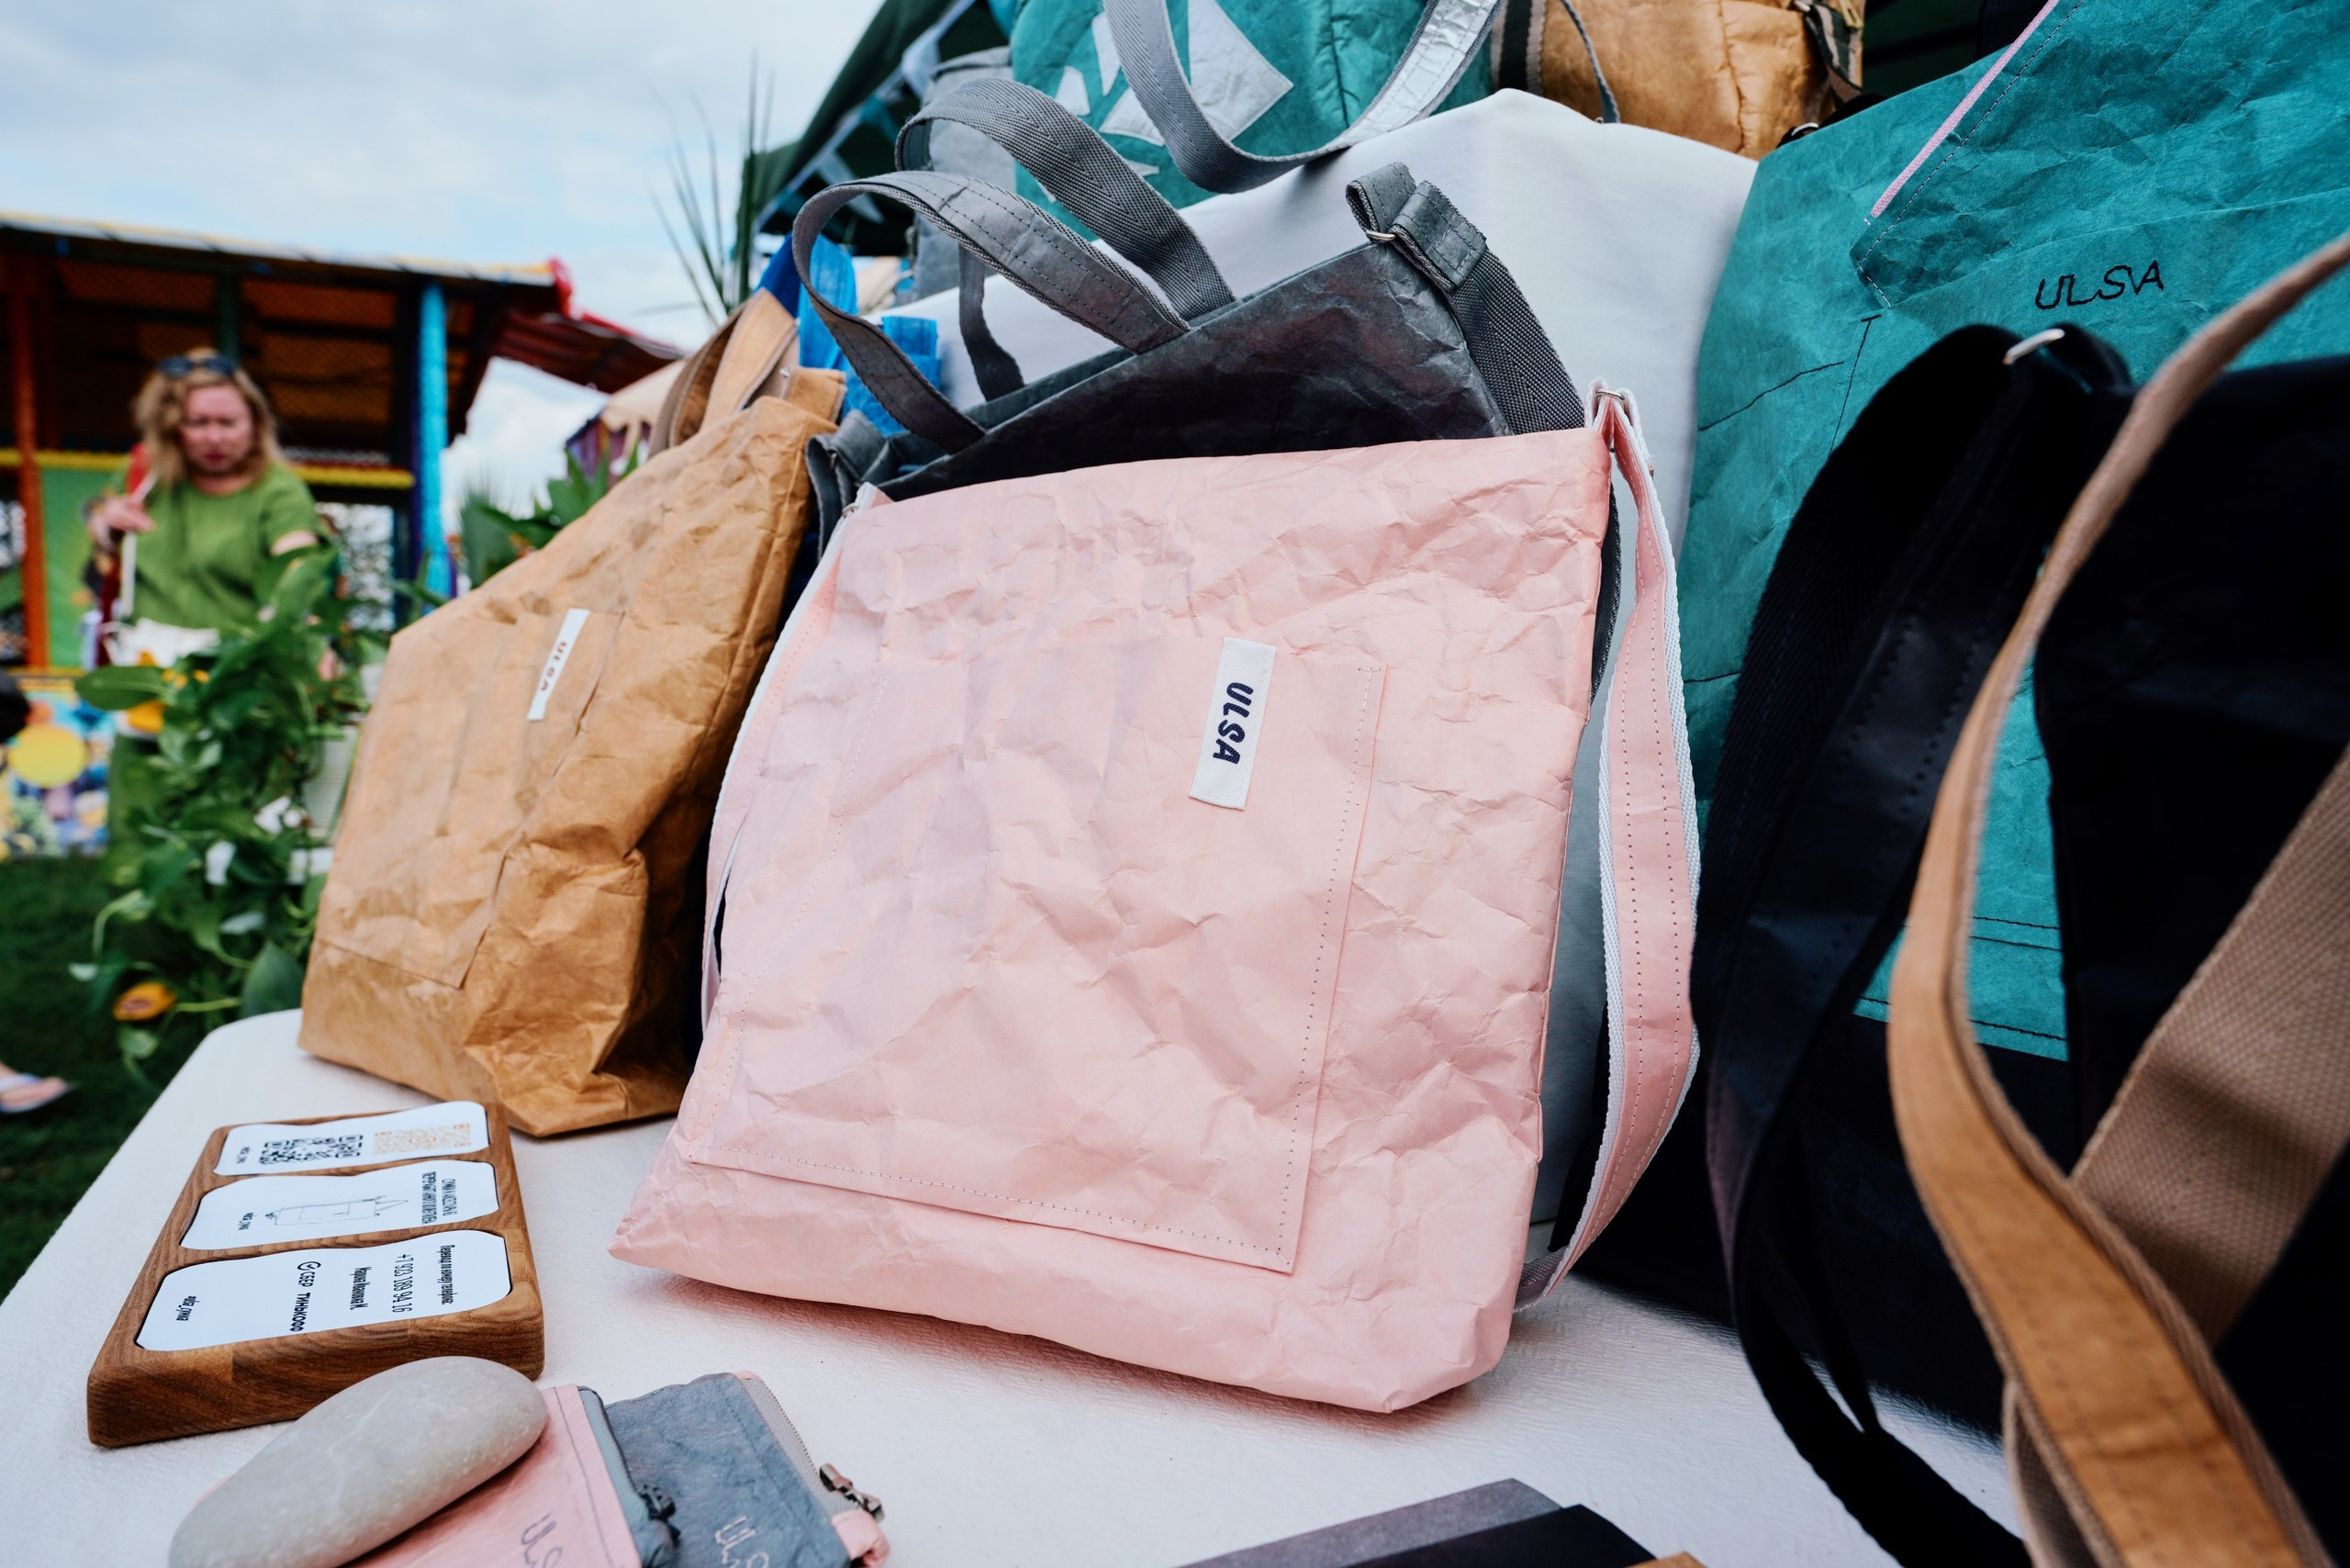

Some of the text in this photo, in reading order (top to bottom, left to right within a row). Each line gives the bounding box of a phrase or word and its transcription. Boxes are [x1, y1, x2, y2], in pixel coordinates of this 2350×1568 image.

[2035, 260, 2165, 310] ULSA
[1213, 682, 1254, 765] ULSA
[350, 1267, 372, 1283] Марина
[437, 1245, 455, 1263] Перевод
[437, 1269, 453, 1283] номеру
[290, 1271, 316, 1331] СБЕР ТИНЬКОФФ
[392, 1254, 414, 1313] +7 923 189 94 16
